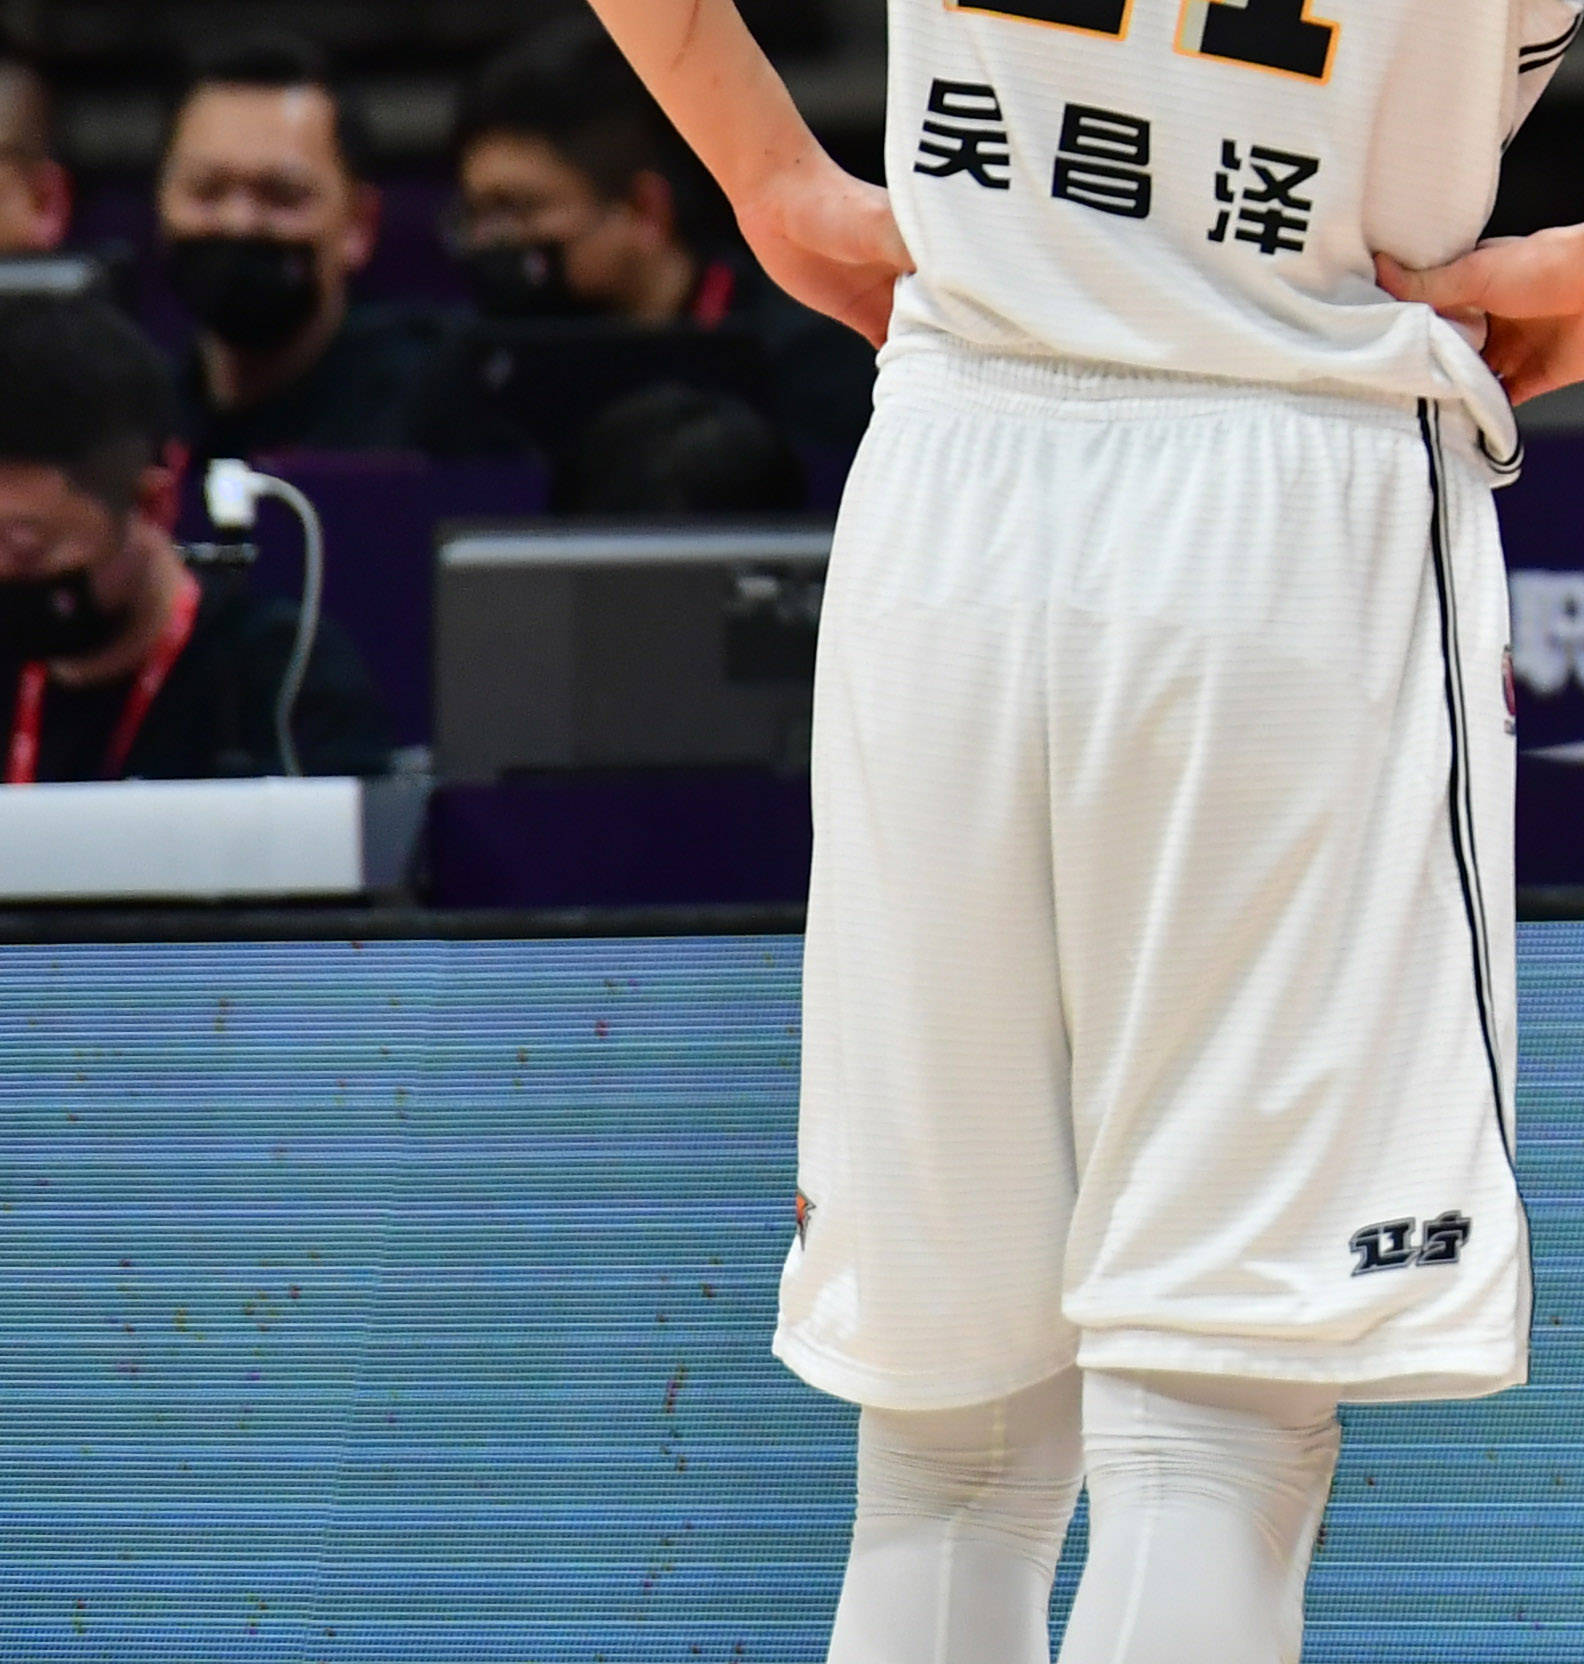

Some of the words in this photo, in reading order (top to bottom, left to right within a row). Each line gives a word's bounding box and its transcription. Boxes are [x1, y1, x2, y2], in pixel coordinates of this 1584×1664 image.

[913, 76, 1321, 257] 吴昌泽
[1348, 1208, 1472, 1277] 辽宁
